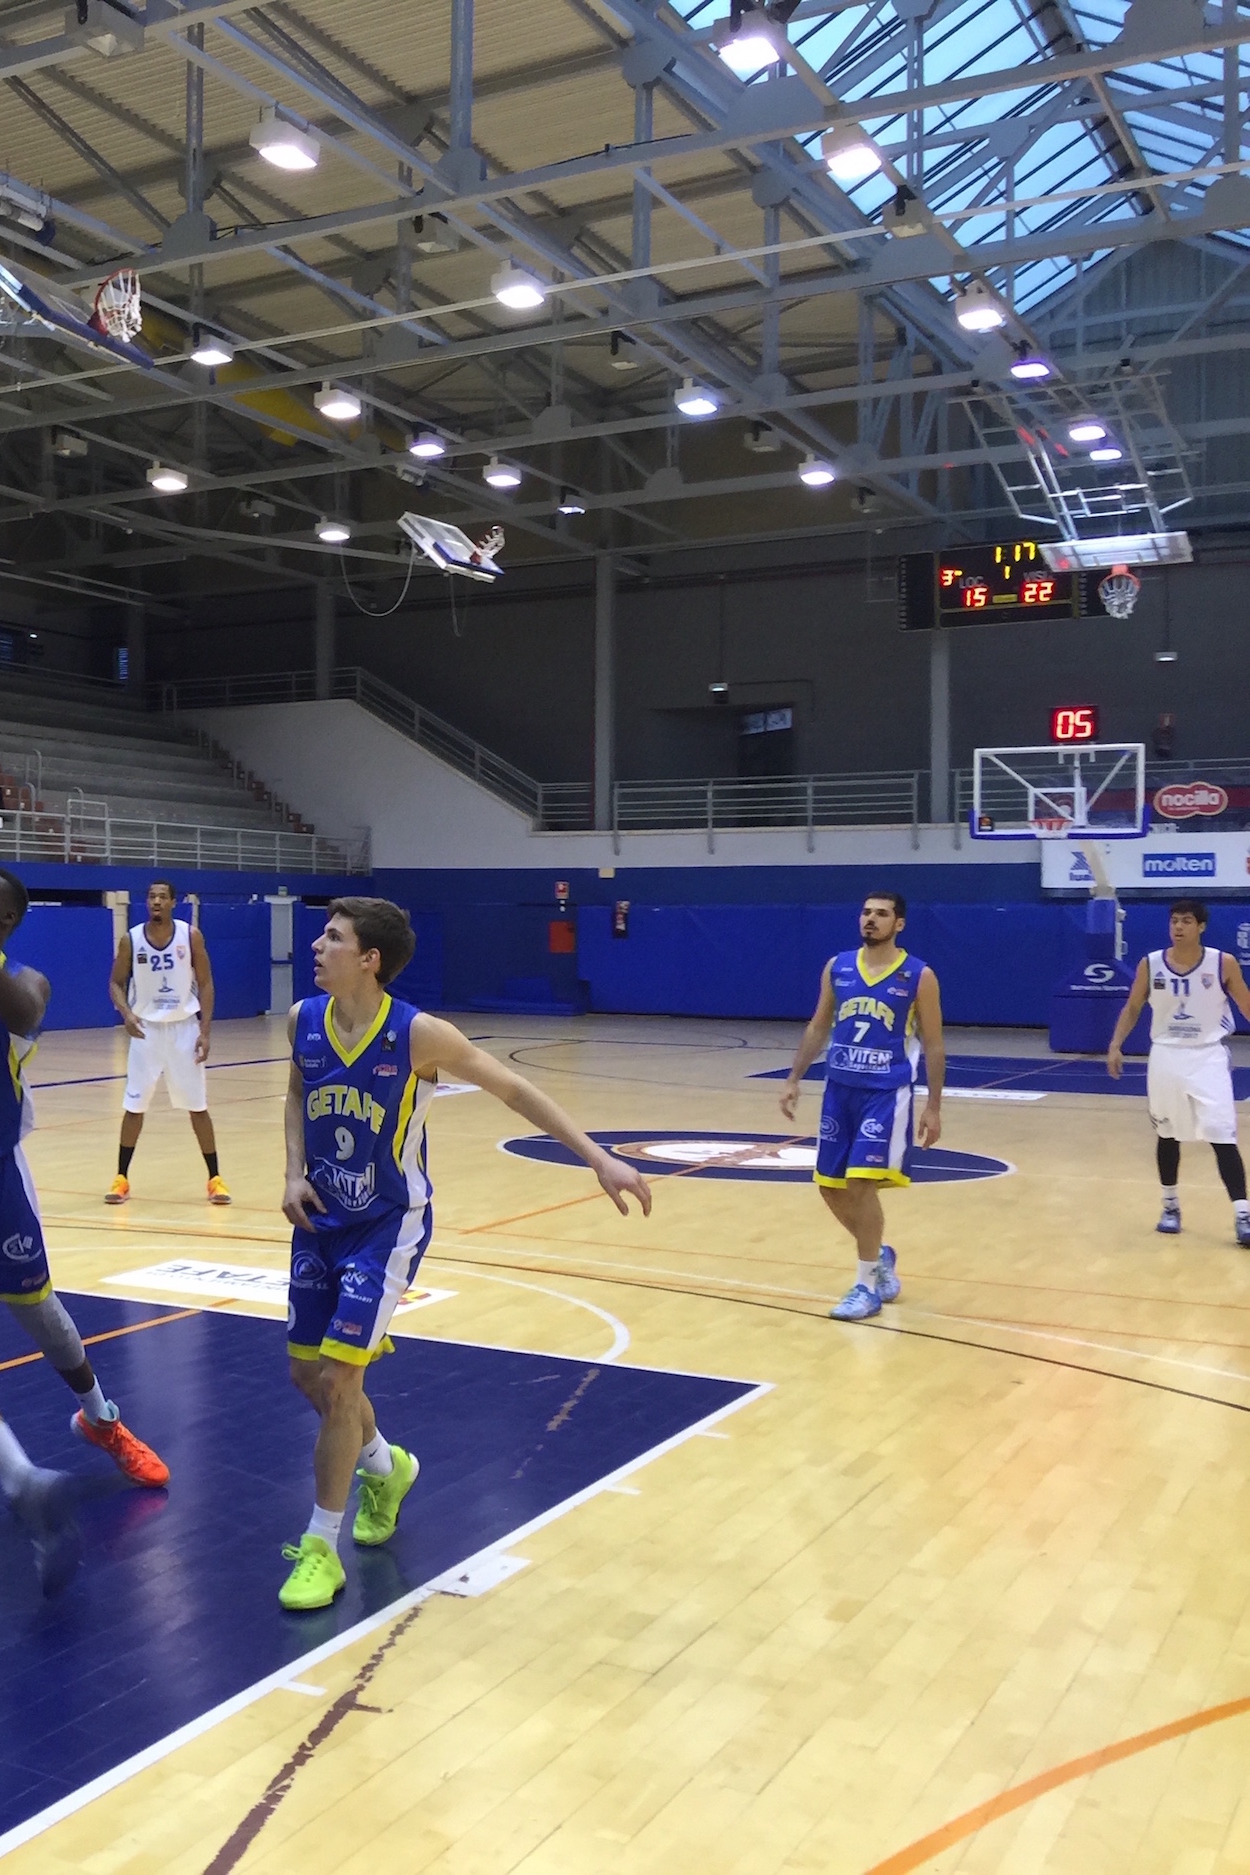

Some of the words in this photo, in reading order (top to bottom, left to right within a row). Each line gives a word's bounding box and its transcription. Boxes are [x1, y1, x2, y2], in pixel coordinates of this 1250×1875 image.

[966, 587, 988, 607] 15
[1024, 582, 1054, 603] 22
[1056, 709, 1093, 739] 05
[1145, 856, 1214, 872] molten
[150, 953, 175, 972] 25
[1170, 978, 1190, 997] 11
[838, 996, 895, 1031] GETAFE
[853, 1020, 871, 1043] 7
[849, 1048, 891, 1065] VITEN
[307, 1084, 386, 1135] GETAFE
[334, 1126, 355, 1161] 9
[156, 1264, 290, 1286] ETAFE
